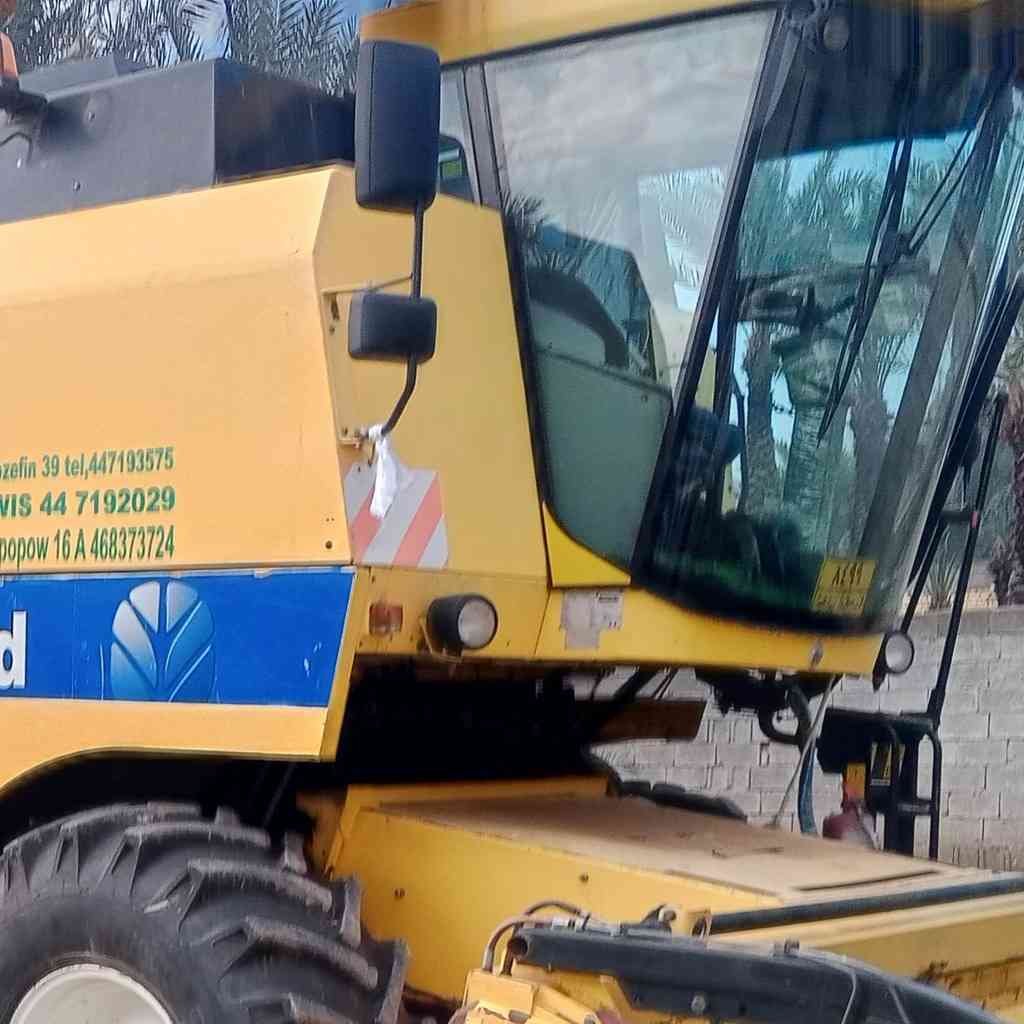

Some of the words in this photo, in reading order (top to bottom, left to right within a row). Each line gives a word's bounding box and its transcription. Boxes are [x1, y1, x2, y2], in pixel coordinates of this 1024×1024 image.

[42, 455, 60, 477] 39
[39, 490, 67, 516] 44
[75, 486, 175, 515] 7192029
[54, 528, 71, 560] 16
[74, 528, 86, 560] A
[90, 525, 174, 560] 468373724
